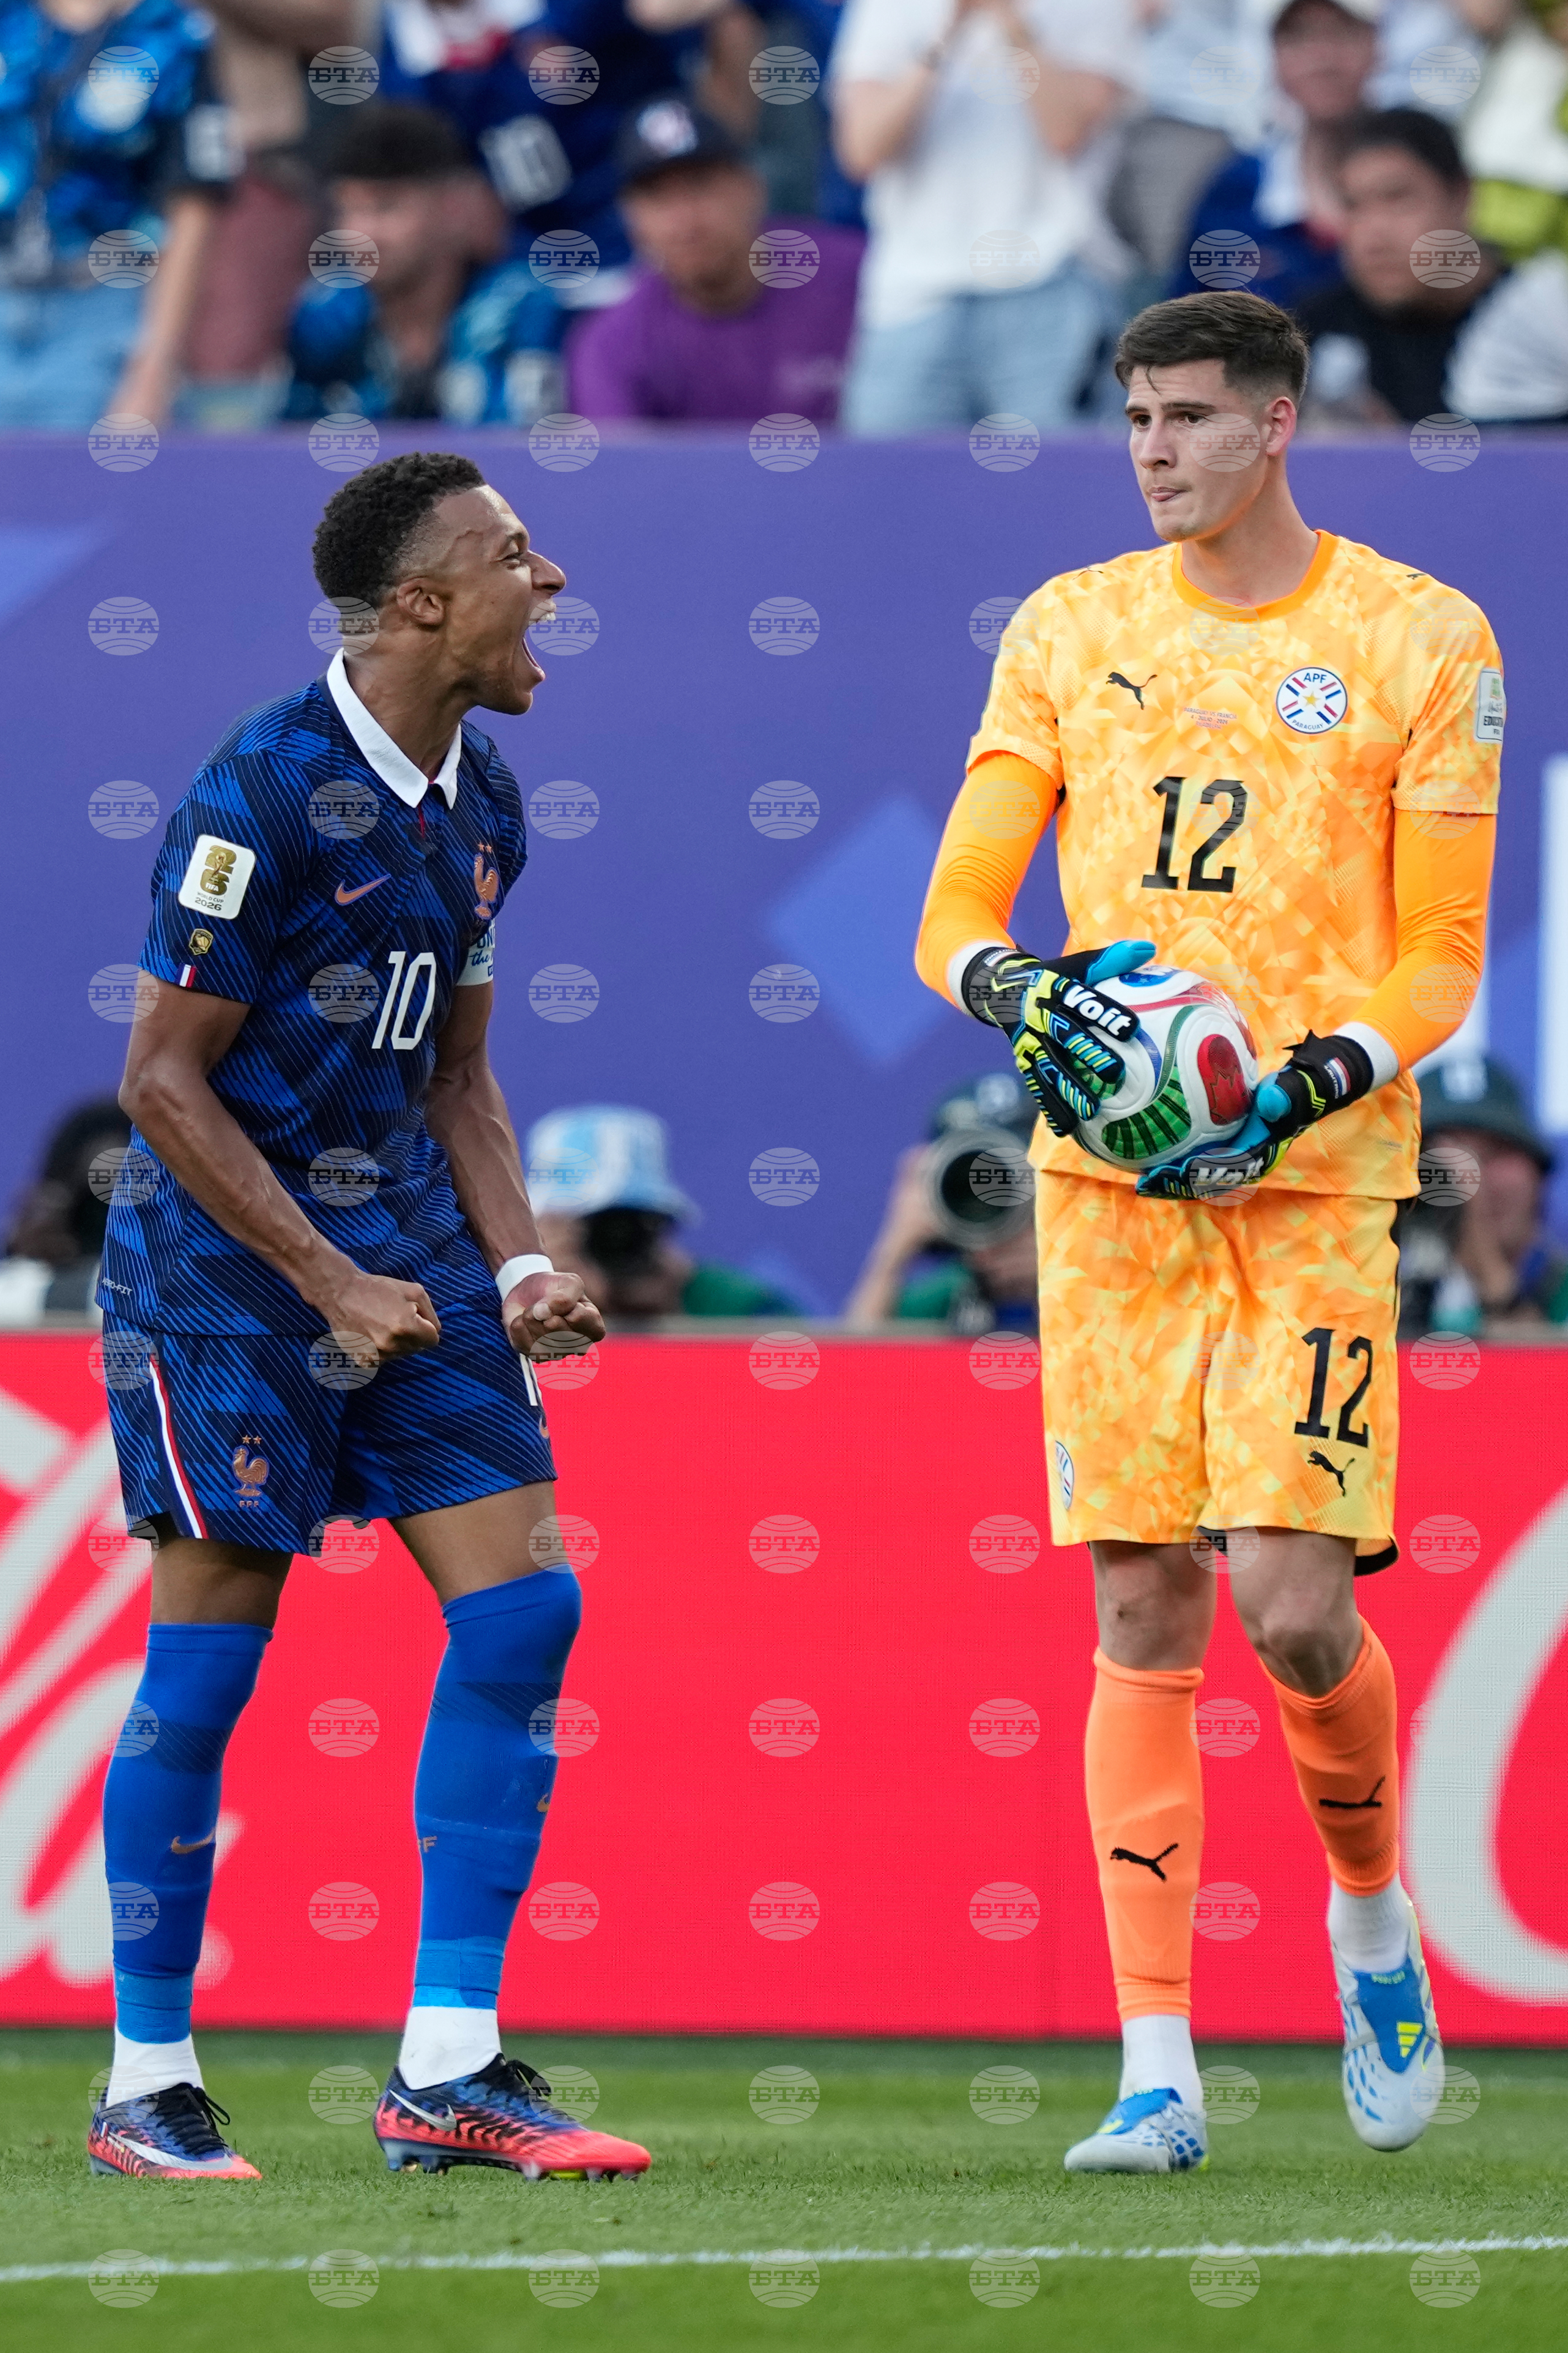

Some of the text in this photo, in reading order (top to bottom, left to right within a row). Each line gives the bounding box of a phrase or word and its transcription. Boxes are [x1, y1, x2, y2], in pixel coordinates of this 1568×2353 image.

[1303, 673, 1327, 684] APF
[1292, 719, 1323, 730] PARAGUAY
[1141, 776, 1248, 893] 12
[205, 882, 219, 892] FIFA
[197, 892, 212, 901] WORLD
[195, 897, 223, 911] 2026
[371, 951, 437, 1050] 10
[1063, 985, 1132, 1036] Voit
[1294, 1327, 1373, 1449] 12
